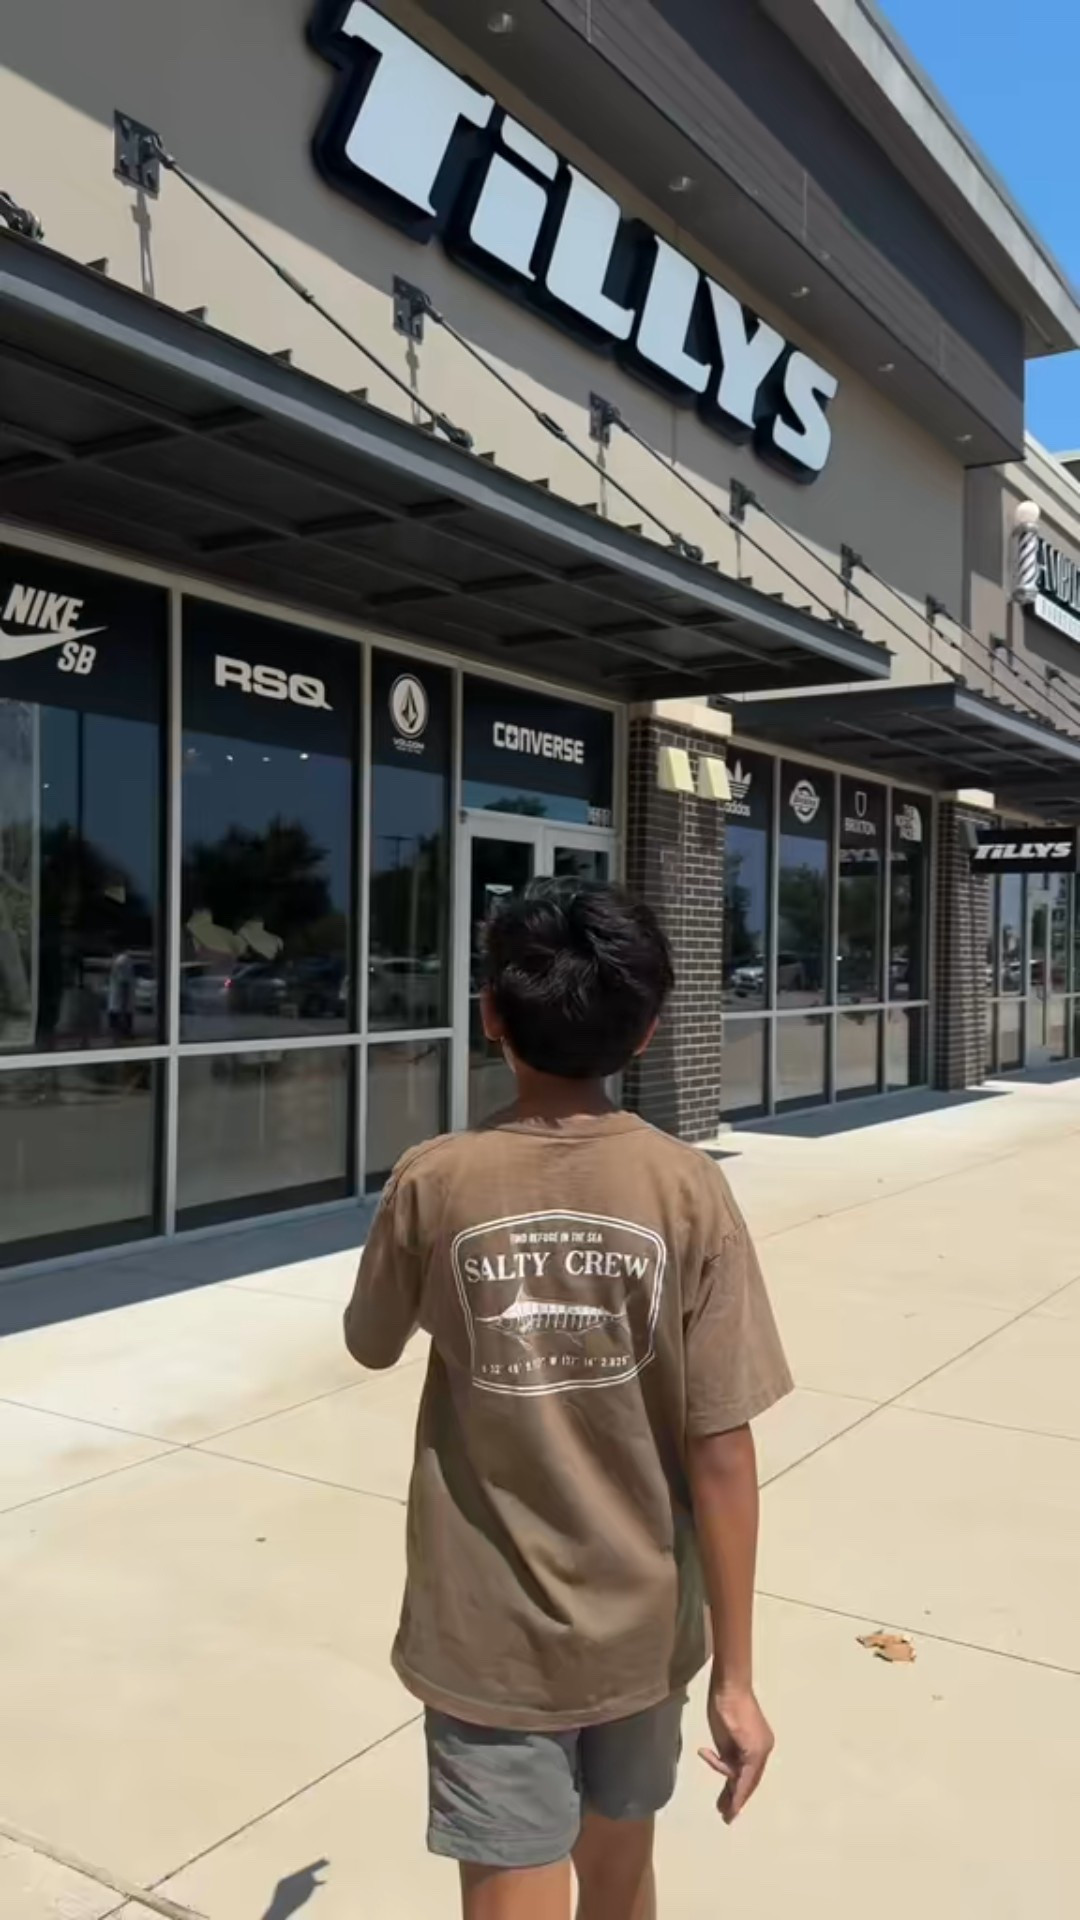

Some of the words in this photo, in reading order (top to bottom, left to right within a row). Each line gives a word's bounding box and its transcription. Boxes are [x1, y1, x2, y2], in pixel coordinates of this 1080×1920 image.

[3, 583, 84, 632] NIKE
[57, 641, 97, 675] SB
[215, 655, 333, 710] RSQ
[493, 721, 585, 764] CONVERSE
[464, 1252, 550, 1283] SALTY
[565, 1250, 649, 1280] CREW
